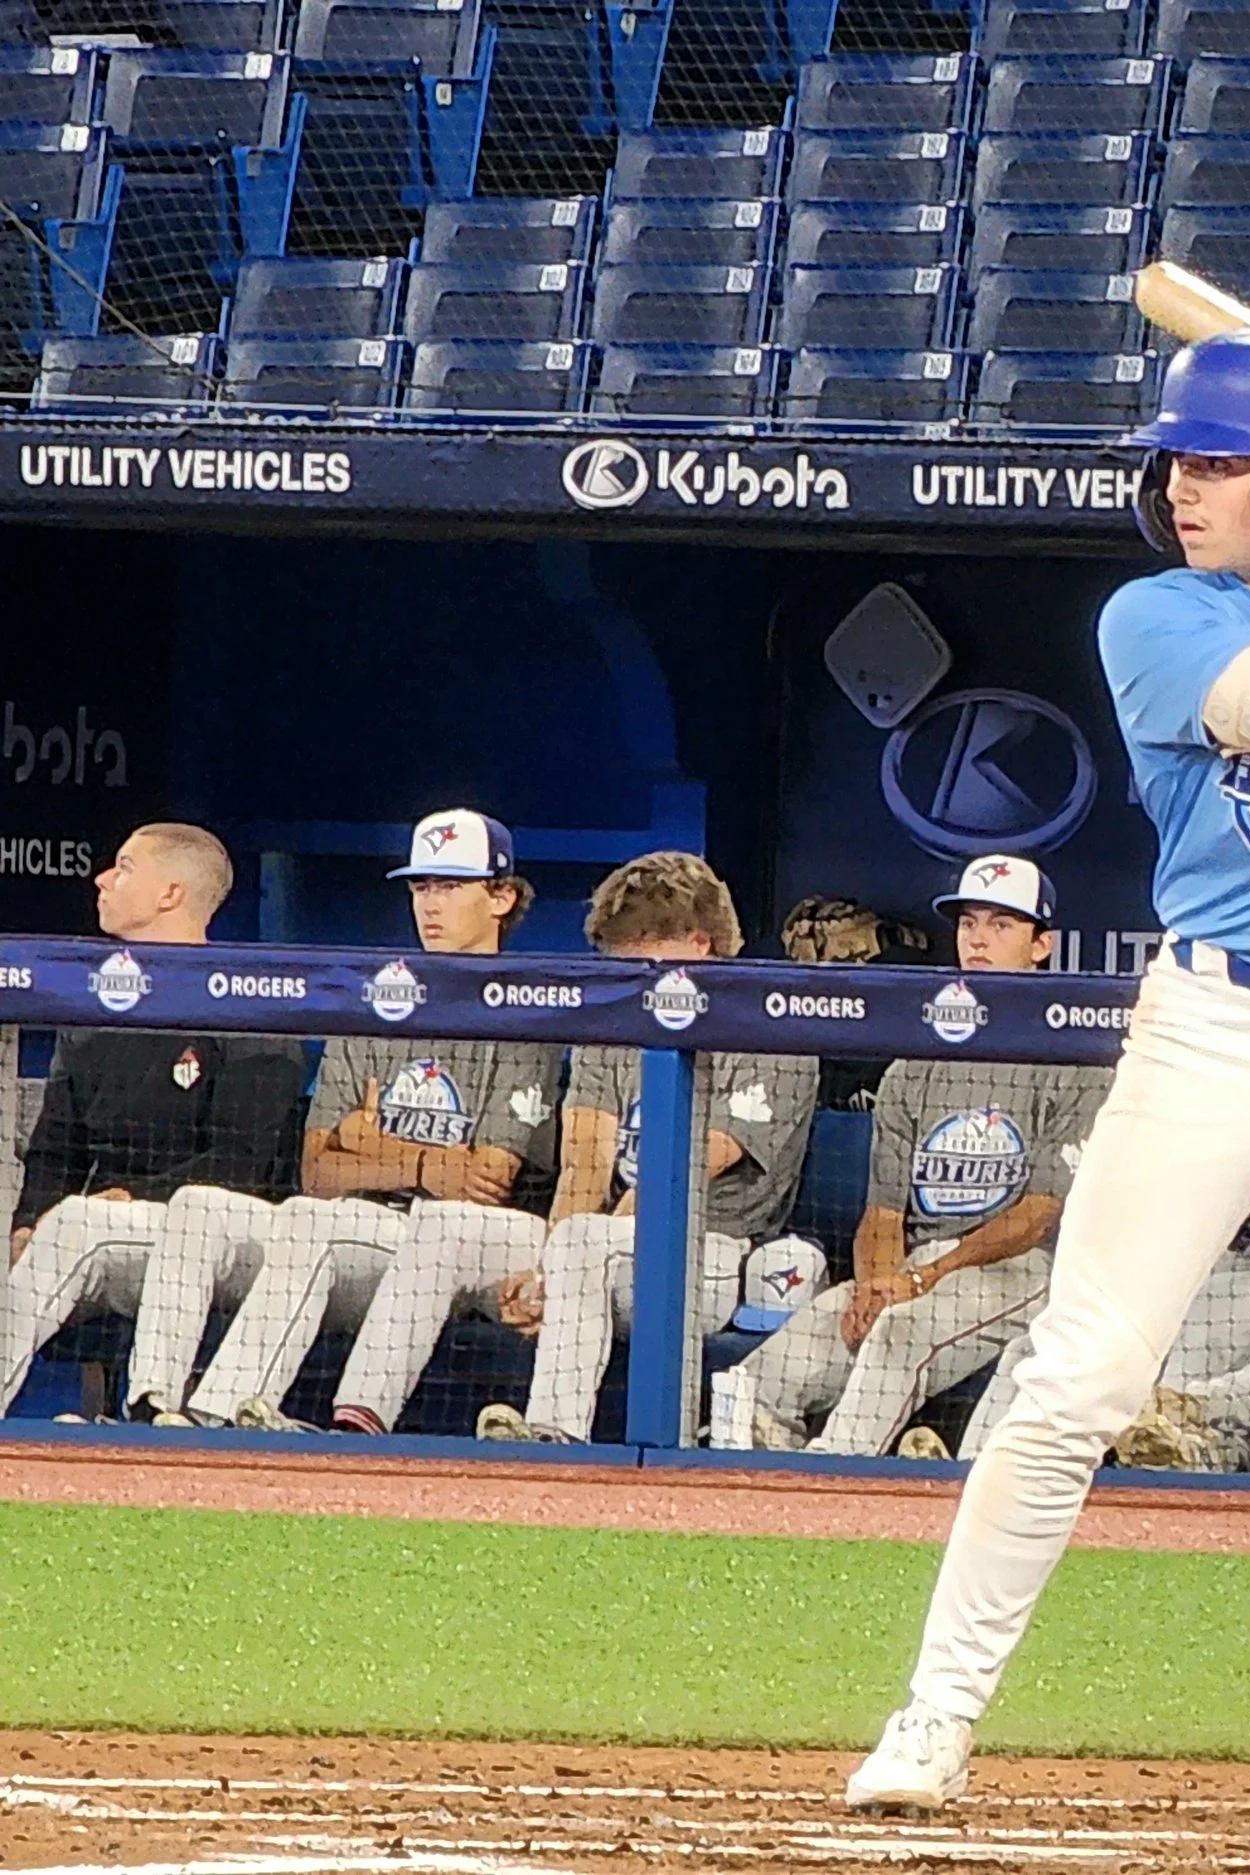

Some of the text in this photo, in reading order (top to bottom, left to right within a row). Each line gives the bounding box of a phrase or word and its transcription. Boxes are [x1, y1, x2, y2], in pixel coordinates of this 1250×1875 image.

[20, 446, 351, 492] UTILITY VEHICLES
[657, 450, 849, 509] Kubota
[913, 464, 1054, 508] UTILITY
[3, 701, 129, 787] bota
[0, 837, 92, 878] HICLES
[0, 967, 32, 989] ERS
[231, 975, 307, 998] ROGERS
[507, 985, 582, 1008] ROGERS
[789, 995, 866, 1019] ROGERS
[1069, 1006, 1133, 1029] ROGER
[383, 1109, 465, 1145] TURES
